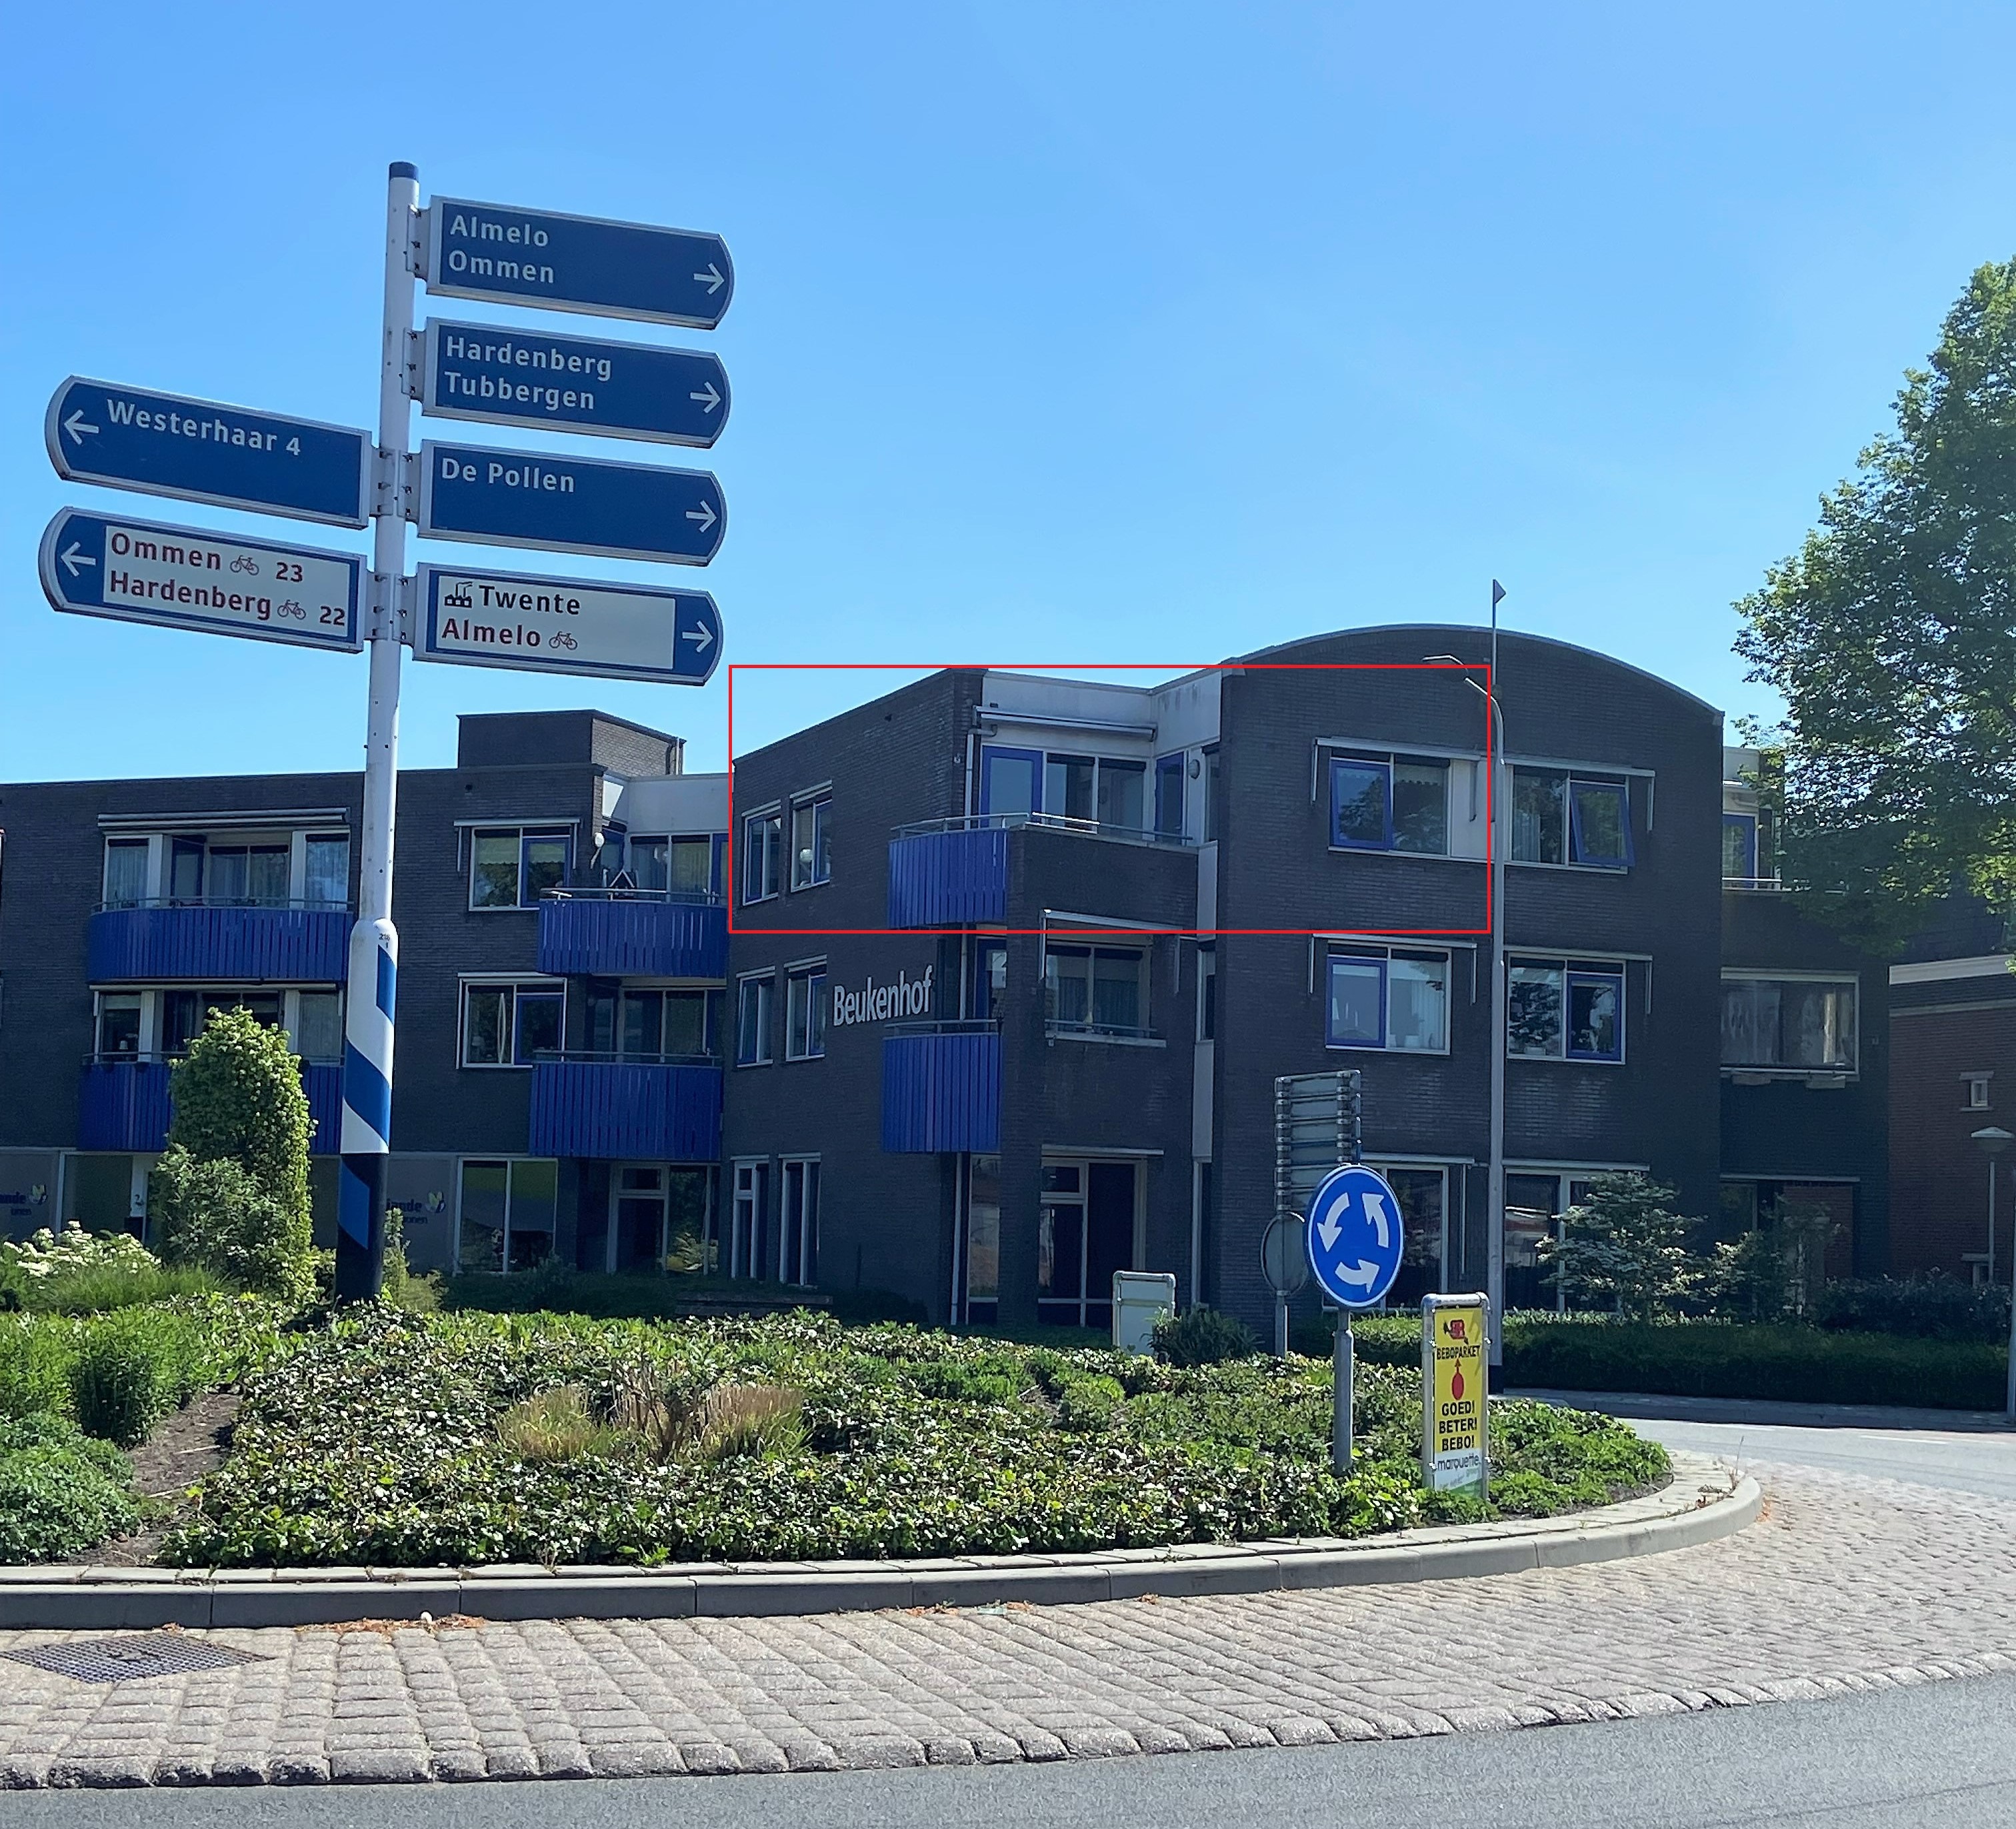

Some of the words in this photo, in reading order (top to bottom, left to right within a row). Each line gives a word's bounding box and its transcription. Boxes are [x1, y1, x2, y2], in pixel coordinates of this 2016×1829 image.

[449, 215, 549, 247] Almelo
[448, 249, 555, 283] Ommen
[446, 335, 612, 381] Hardenberg
[444, 371, 595, 411] Tubbergen
[107, 399, 277, 451] Westerhaar
[285, 437, 301, 456] 4
[441, 458, 477, 482] De
[487, 462, 575, 493] Pollen
[111, 532, 221, 571] Ommen
[275, 561, 303, 583] 23
[110, 570, 271, 621] Hardenberg
[319, 605, 345, 626] 22
[479, 585, 581, 615] Twente
[441, 618, 541, 647] Almelo
[833, 965, 933, 1026] Beukenhof
[1437, 1345, 1480, 1360] BEBOPARKET
[1441, 1400, 1475, 1416] GOED!
[1439, 1418, 1477, 1434] BETER!
[1441, 1436, 1475, 1451] BEBO!
